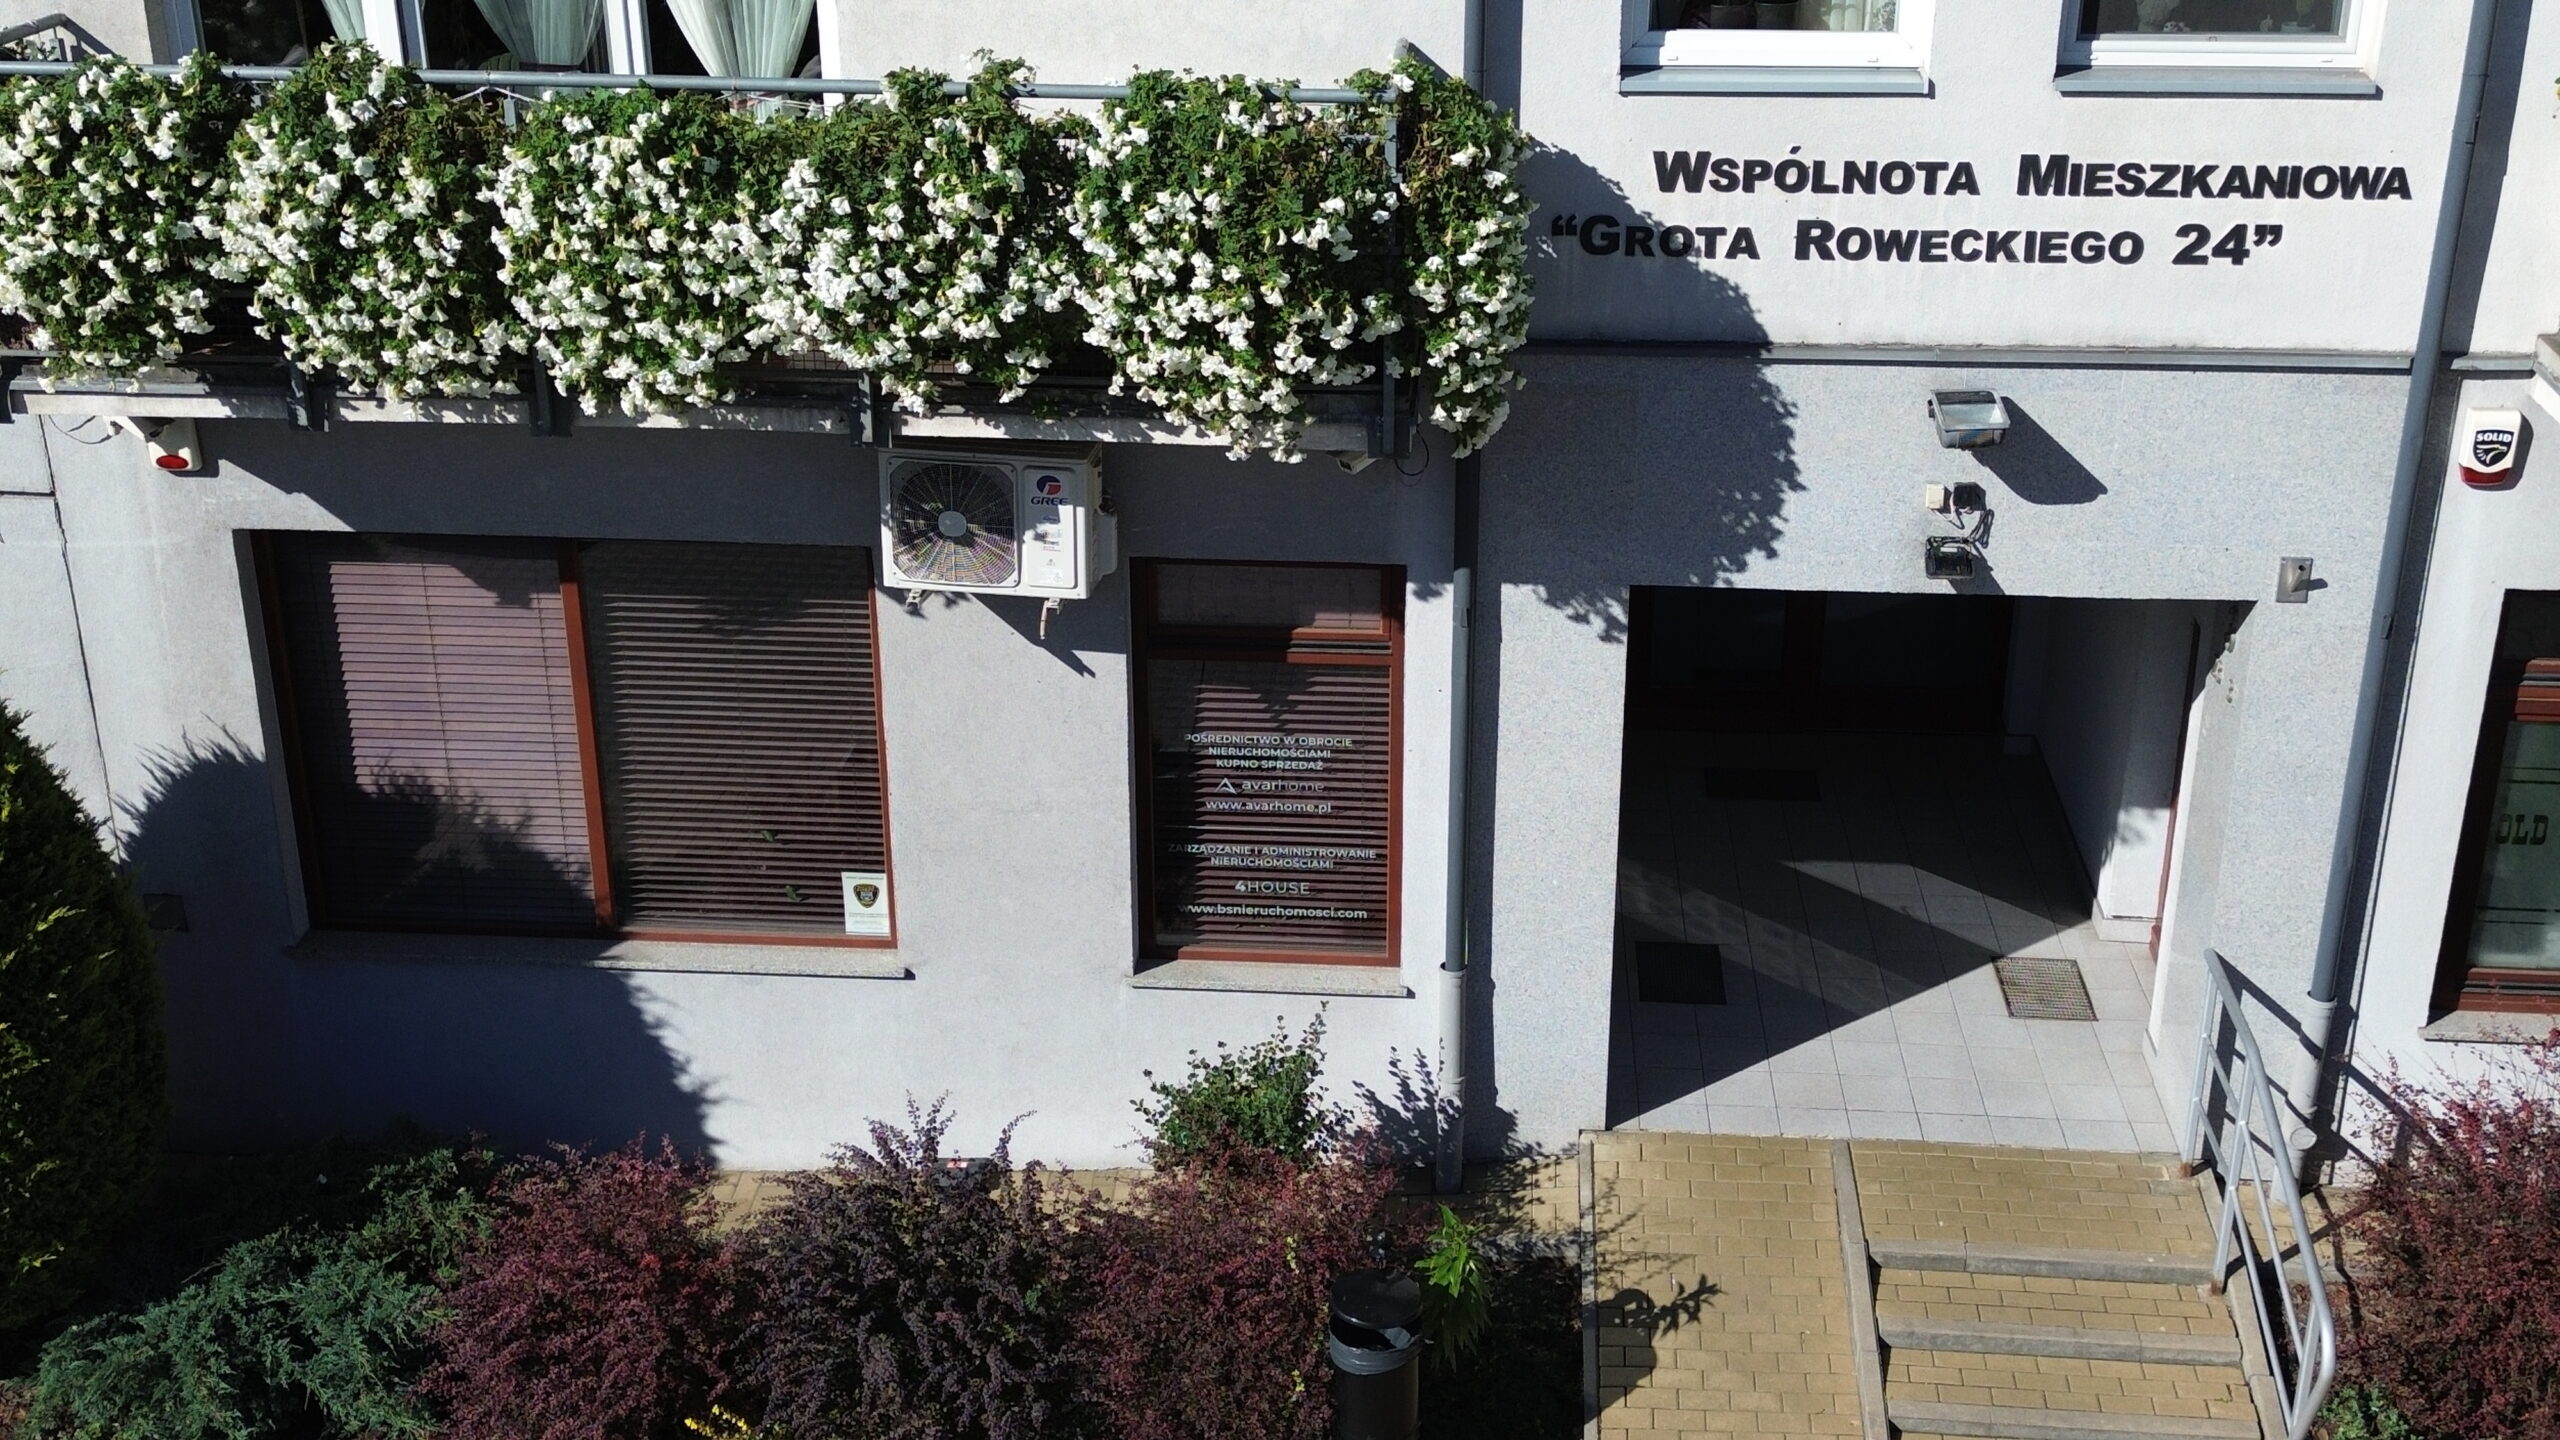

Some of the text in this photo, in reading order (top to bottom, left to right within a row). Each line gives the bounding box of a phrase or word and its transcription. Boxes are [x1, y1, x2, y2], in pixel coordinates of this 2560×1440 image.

[2171, 223, 2284, 266] 24”
[2476, 432, 2512, 443] SOLID
[1030, 496, 1069, 506] GREE
[1184, 731, 1353, 747] POŚREDNICTWO W OBROCIE
[1208, 746, 1331, 758] NIERUCHOMOŚCIAMI
[1216, 759, 1324, 770] KUPNO SPRZEDAŻ
[1241, 779, 1325, 792] avarhome
[1205, 800, 1332, 815] www.avarhome.pl
[1261, 846, 1377, 859] ADMINISTROWANIE
[1210, 856, 1334, 869] NIERUCHOMOŚCIAMI
[1235, 880, 1311, 895] 4HOUSE
[1178, 903, 1368, 919] www.bsnieruchomosci.com
